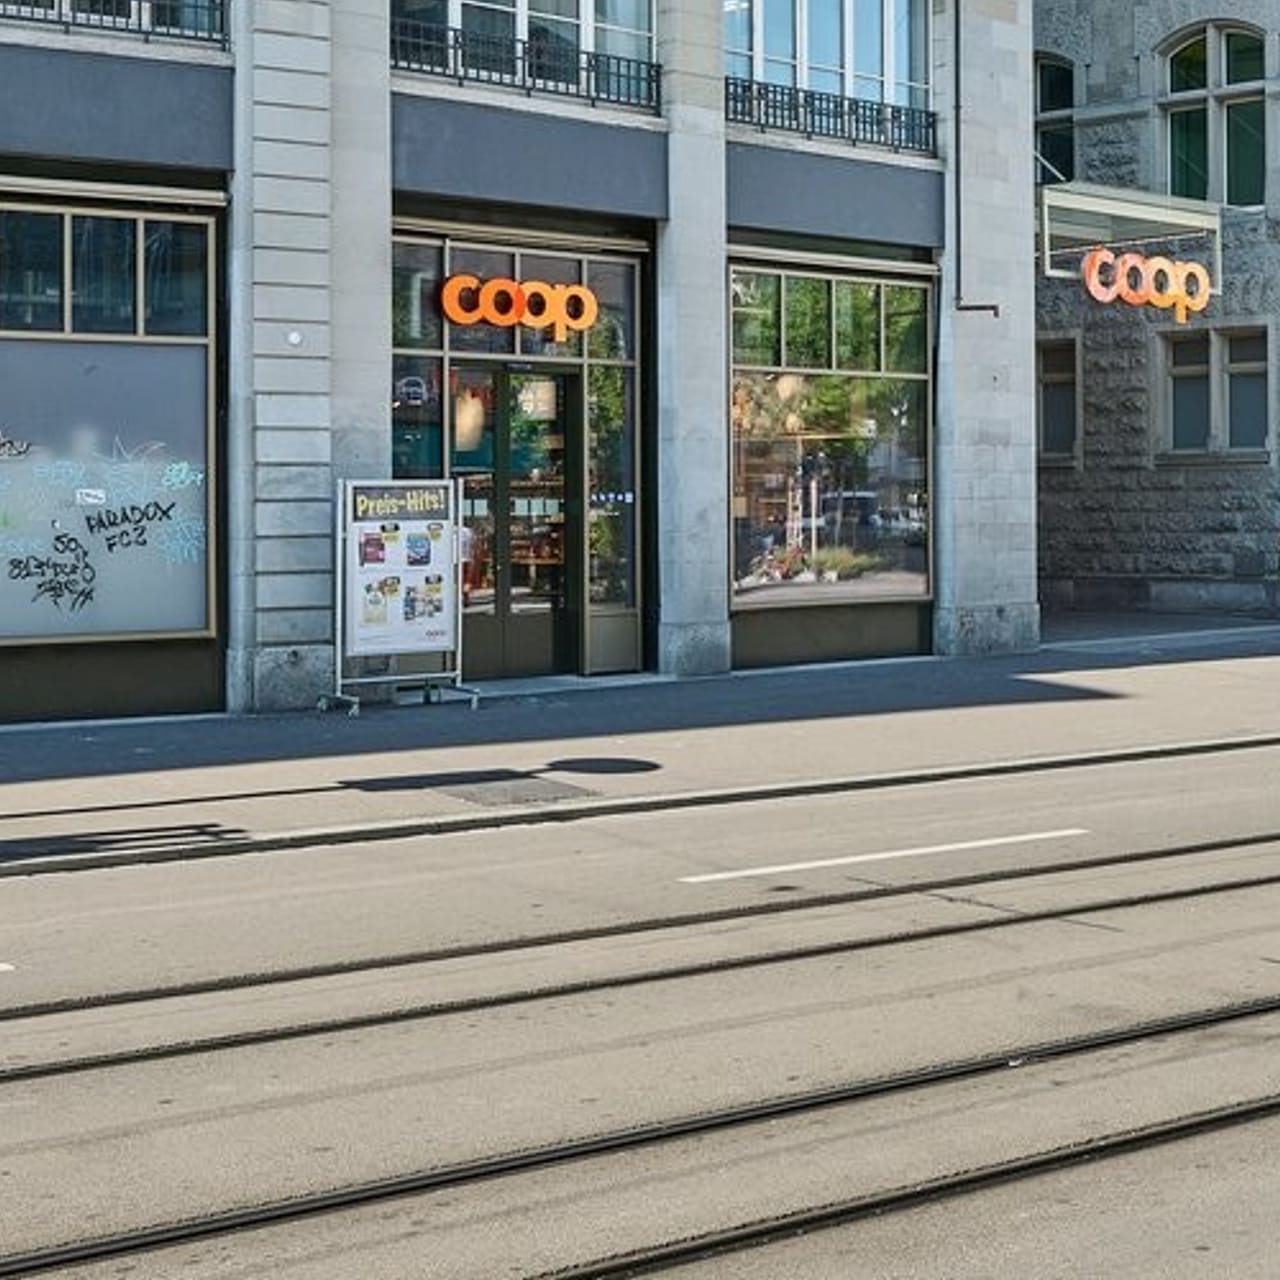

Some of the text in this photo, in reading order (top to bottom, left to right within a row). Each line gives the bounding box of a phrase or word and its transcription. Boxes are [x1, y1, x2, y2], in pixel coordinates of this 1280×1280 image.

[442, 275, 598, 342] coop
[1082, 245, 1210, 324] coop
[86, 501, 176, 535] PARADOX
[356, 488, 445, 517] Preis-Hits!
